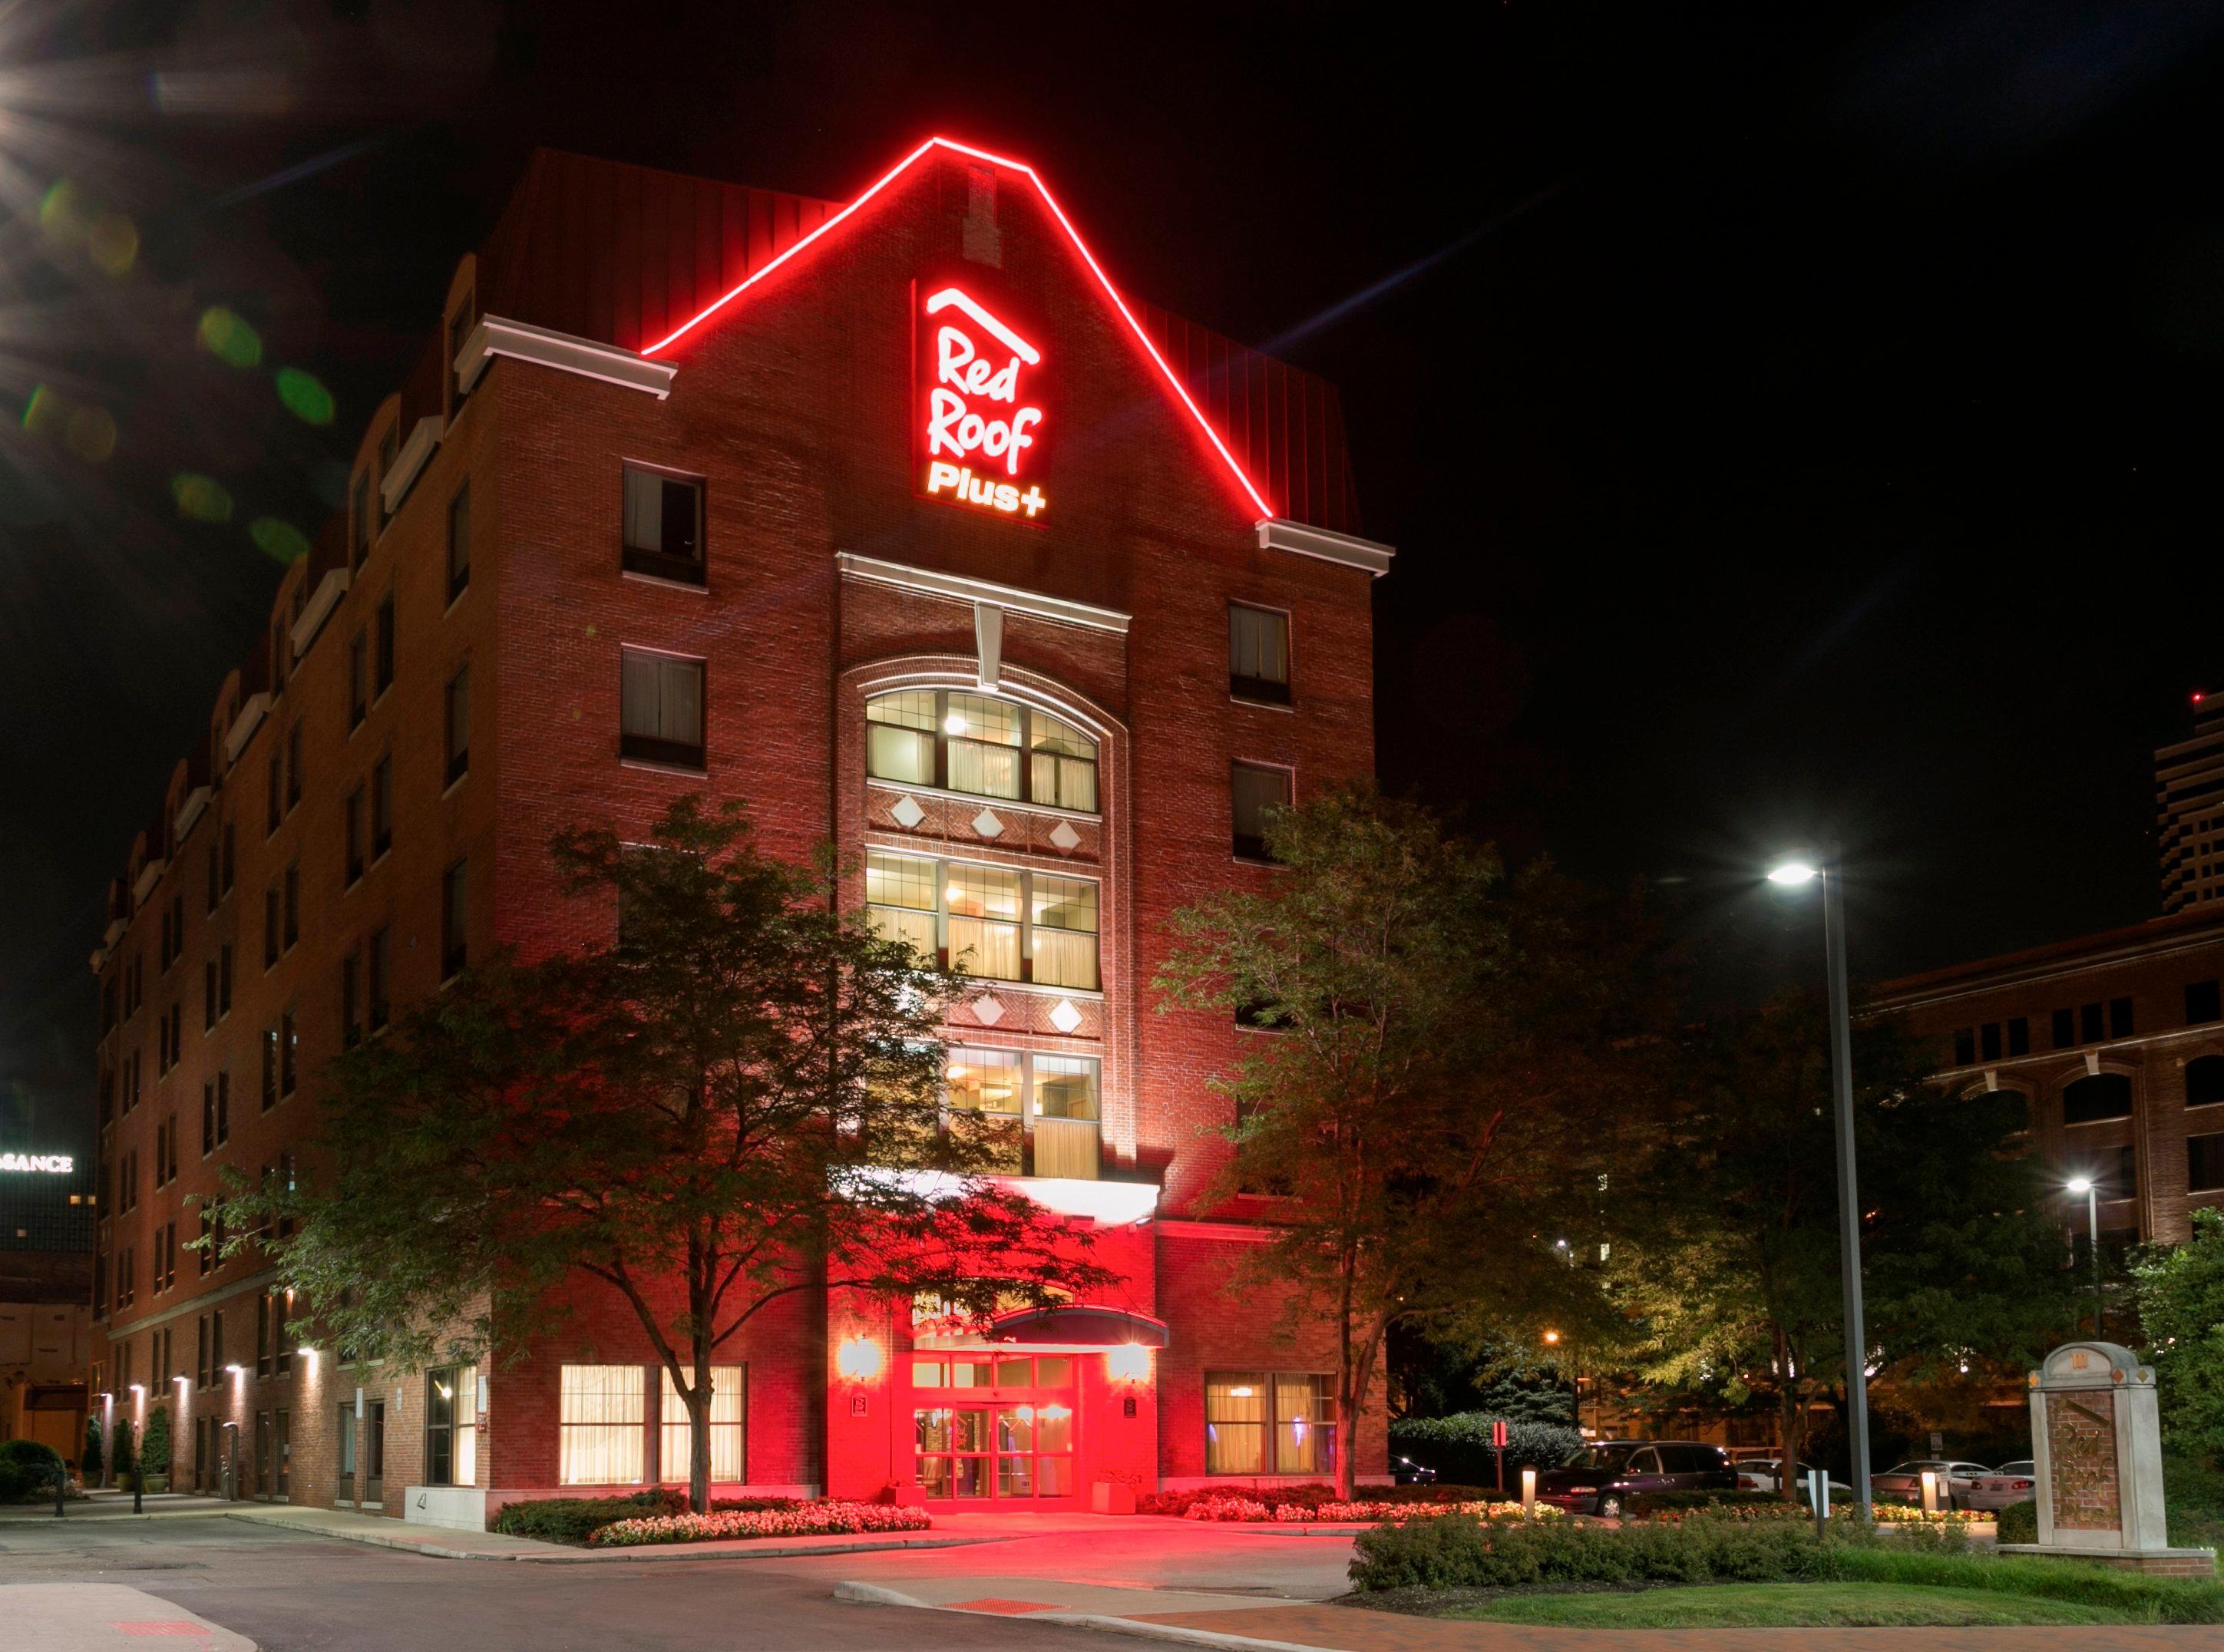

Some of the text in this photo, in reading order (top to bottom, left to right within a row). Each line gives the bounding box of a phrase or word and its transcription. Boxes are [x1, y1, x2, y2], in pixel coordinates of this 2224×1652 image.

[937, 325, 1021, 404] Red
[927, 387, 1043, 475] Roof
[927, 461, 1046, 517] Plus+
[0, 1153, 73, 1172] SANCE
[2059, 1422, 2100, 1459] Red
[2058, 1456, 2113, 1498] Roof
